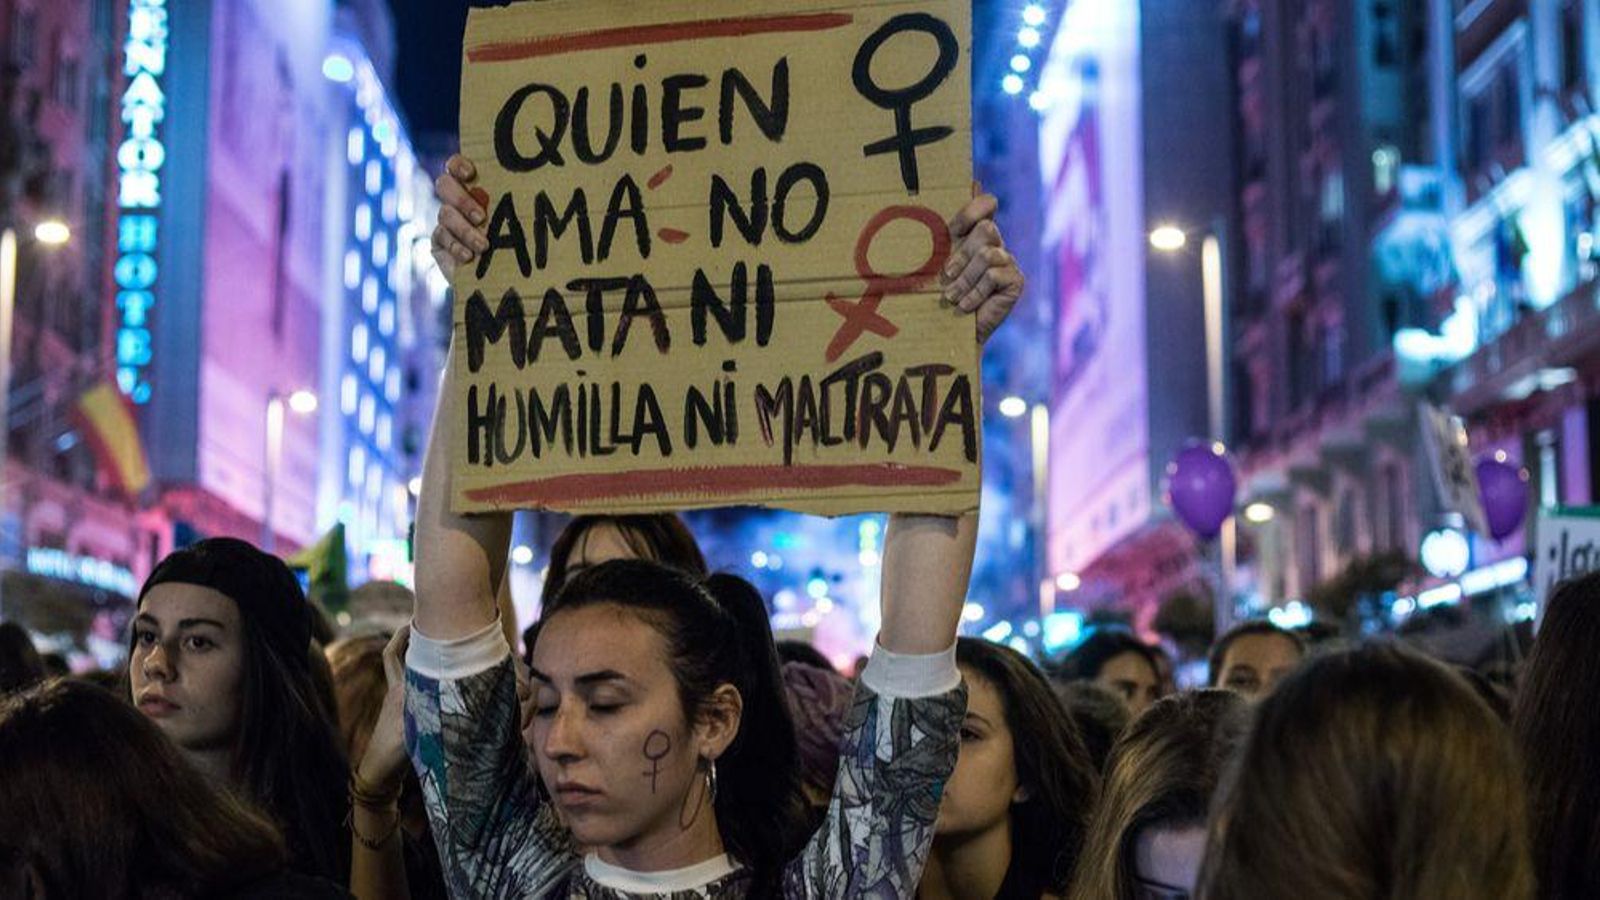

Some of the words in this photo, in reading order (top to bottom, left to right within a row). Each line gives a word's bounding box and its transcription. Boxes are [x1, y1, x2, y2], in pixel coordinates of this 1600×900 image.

[117, 0, 168, 208] ENATOR
[709, 161, 830, 248] NO
[114, 214, 158, 405] HOTEL
[464, 274, 671, 373] MATA
[691, 261, 775, 347] NI
[754, 352, 978, 466] MALTRATA
